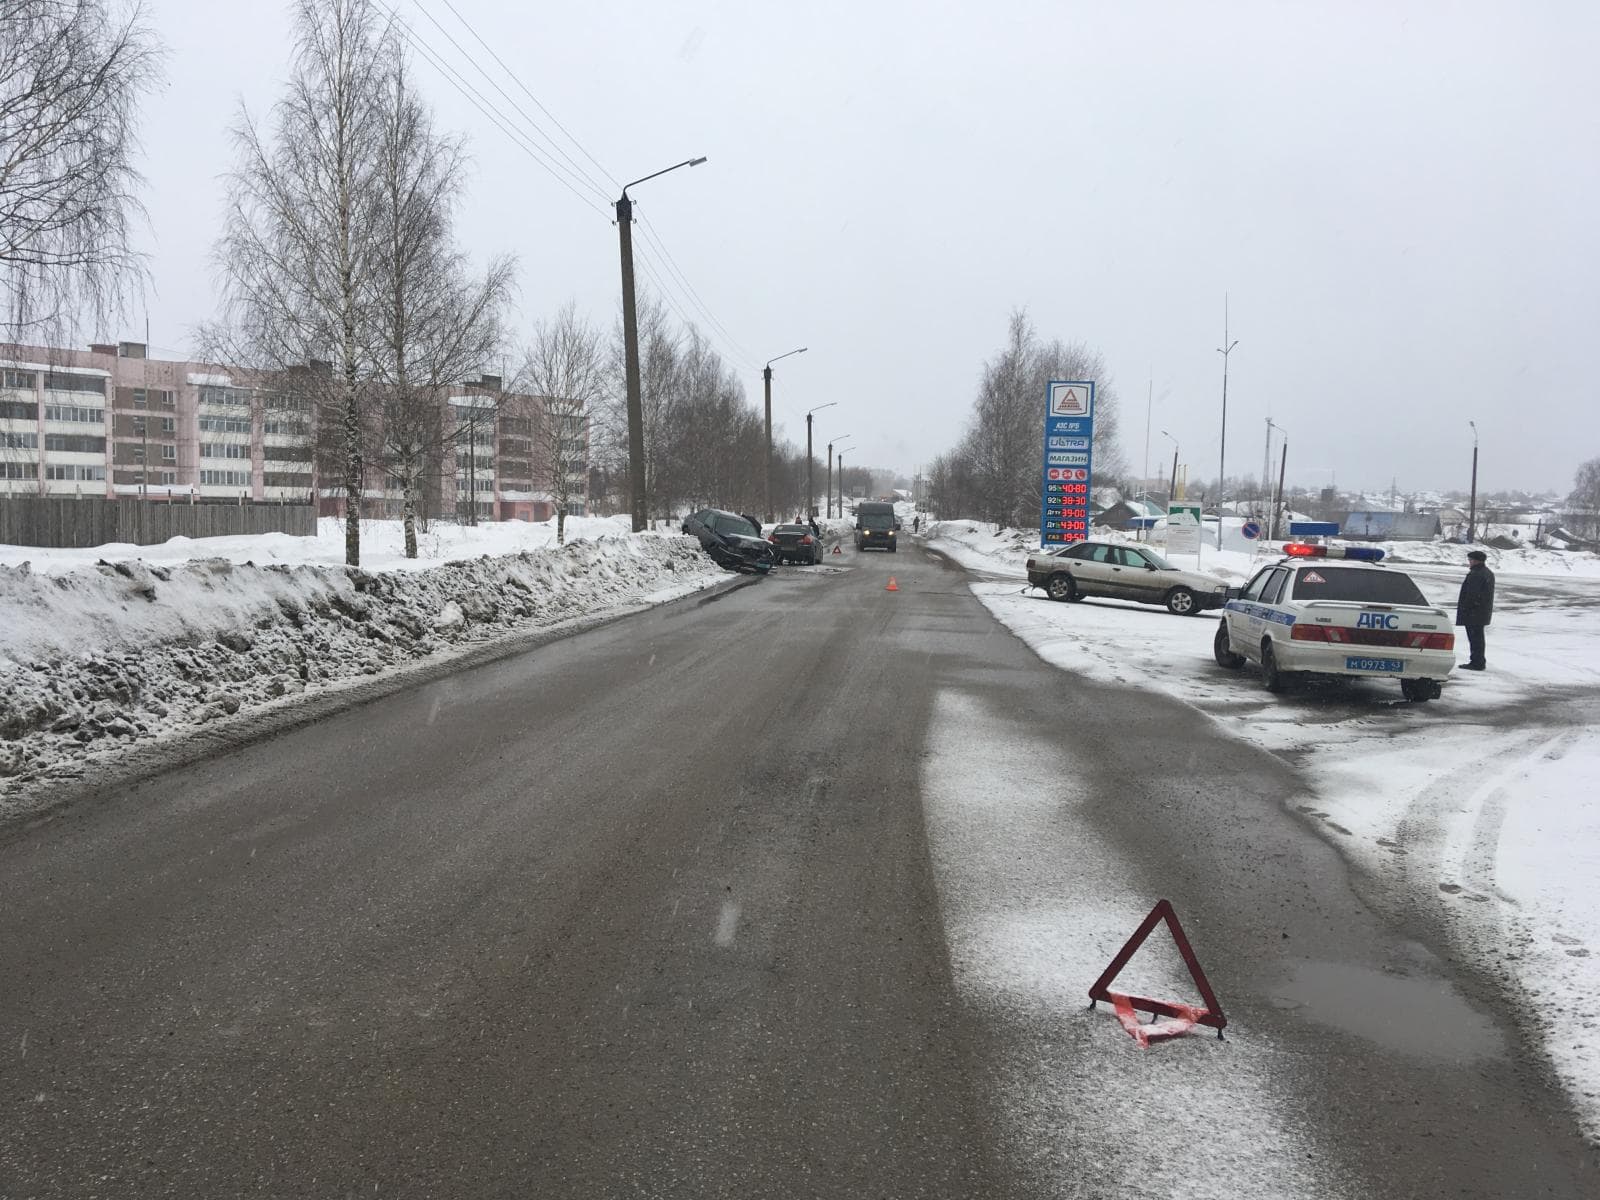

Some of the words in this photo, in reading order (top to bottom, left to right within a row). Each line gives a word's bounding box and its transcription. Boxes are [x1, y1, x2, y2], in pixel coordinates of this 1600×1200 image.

[1048, 484, 1057, 492] 95
[1357, 612, 1400, 630] ДПС
[1361, 660, 1385, 670] 0973
